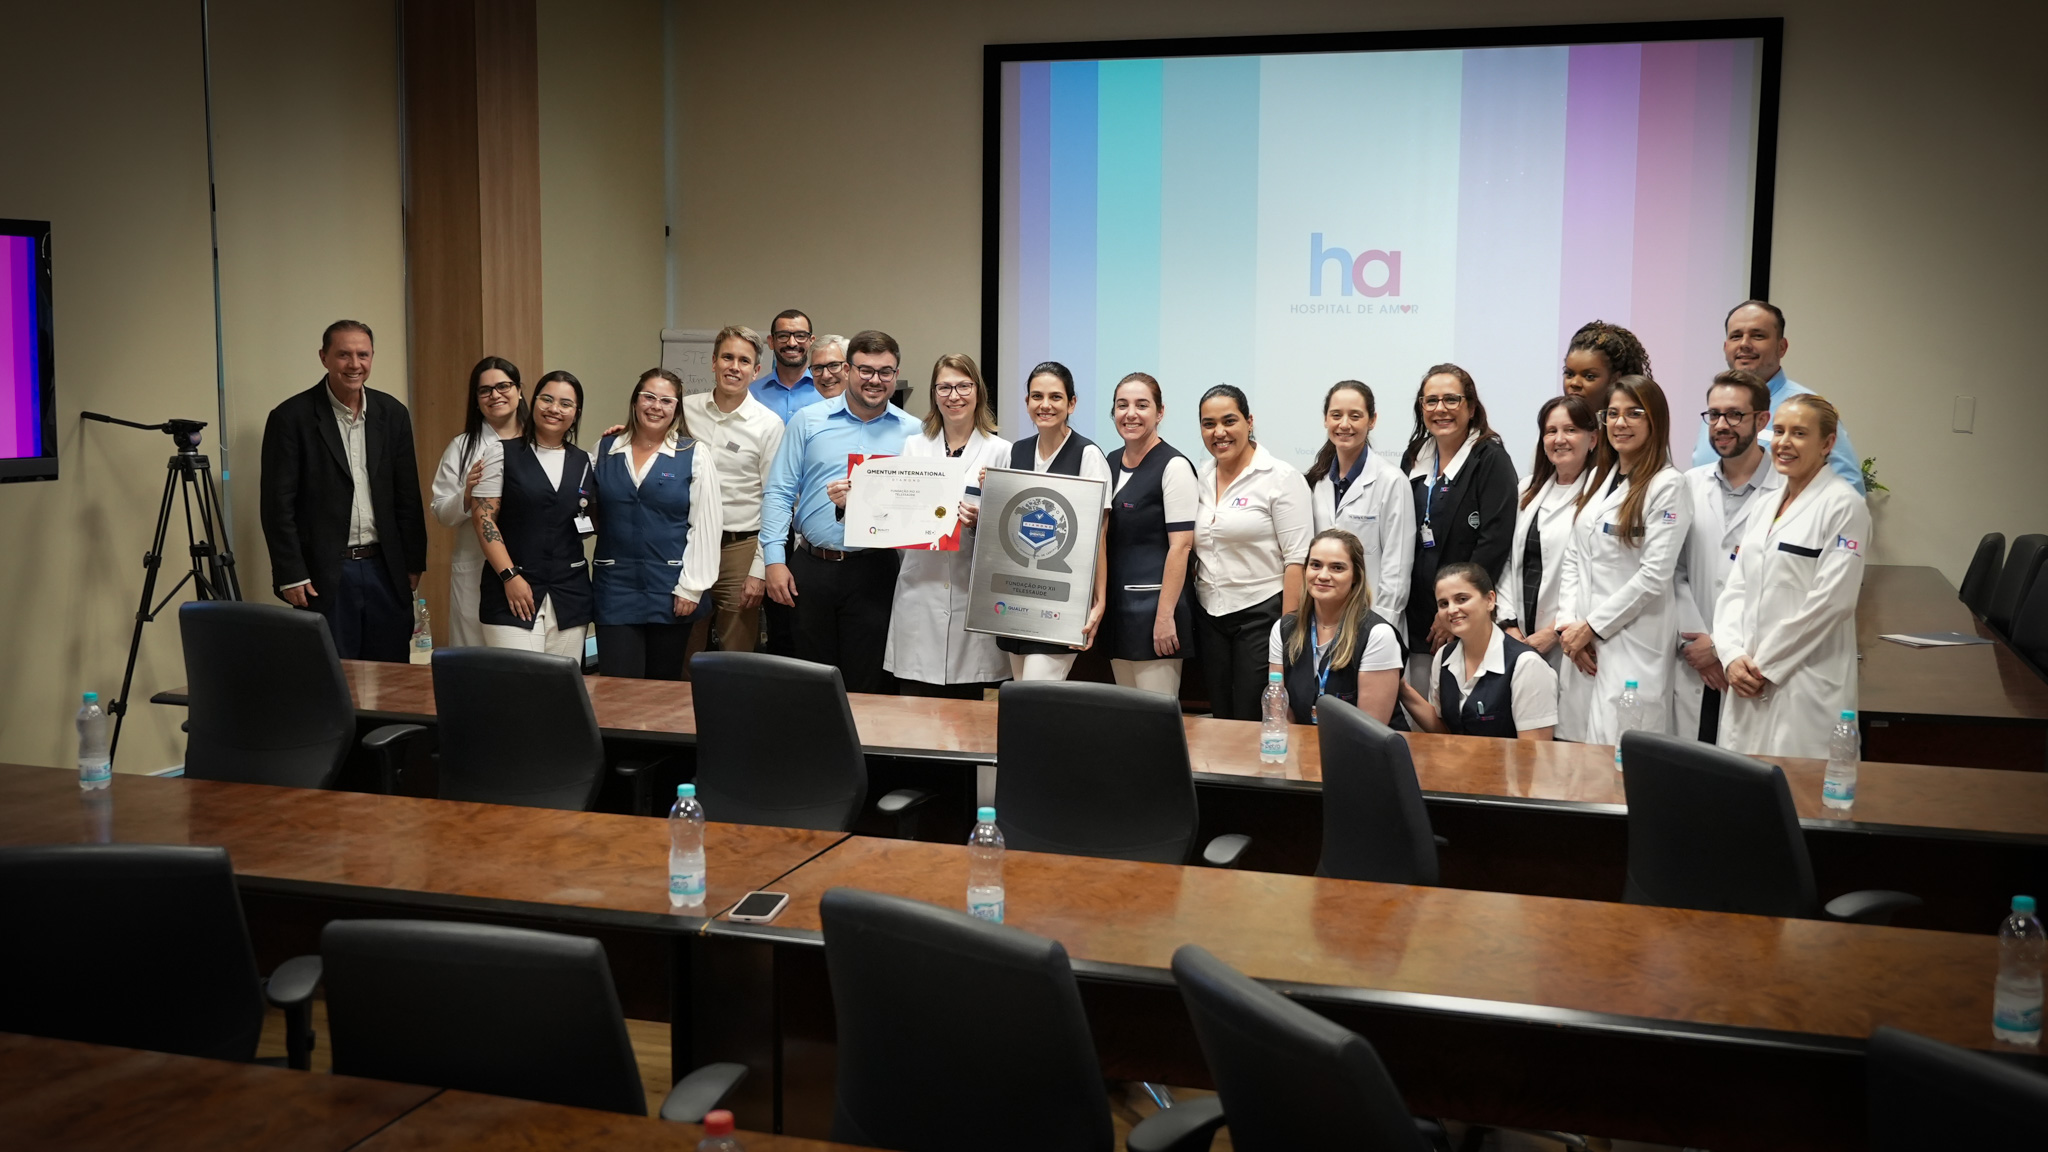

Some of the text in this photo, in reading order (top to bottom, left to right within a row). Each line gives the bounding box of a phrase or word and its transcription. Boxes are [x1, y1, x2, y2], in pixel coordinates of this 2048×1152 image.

[1309, 232, 1402, 298] ha
[1290, 304, 1352, 314] HOSPITAL
[1357, 304, 1374, 314] DE
[1837, 534, 1858, 550] ha
[1005, 580, 1036, 589] FUNDAÇÃO
[1008, 605, 1029, 613] QUALITY
